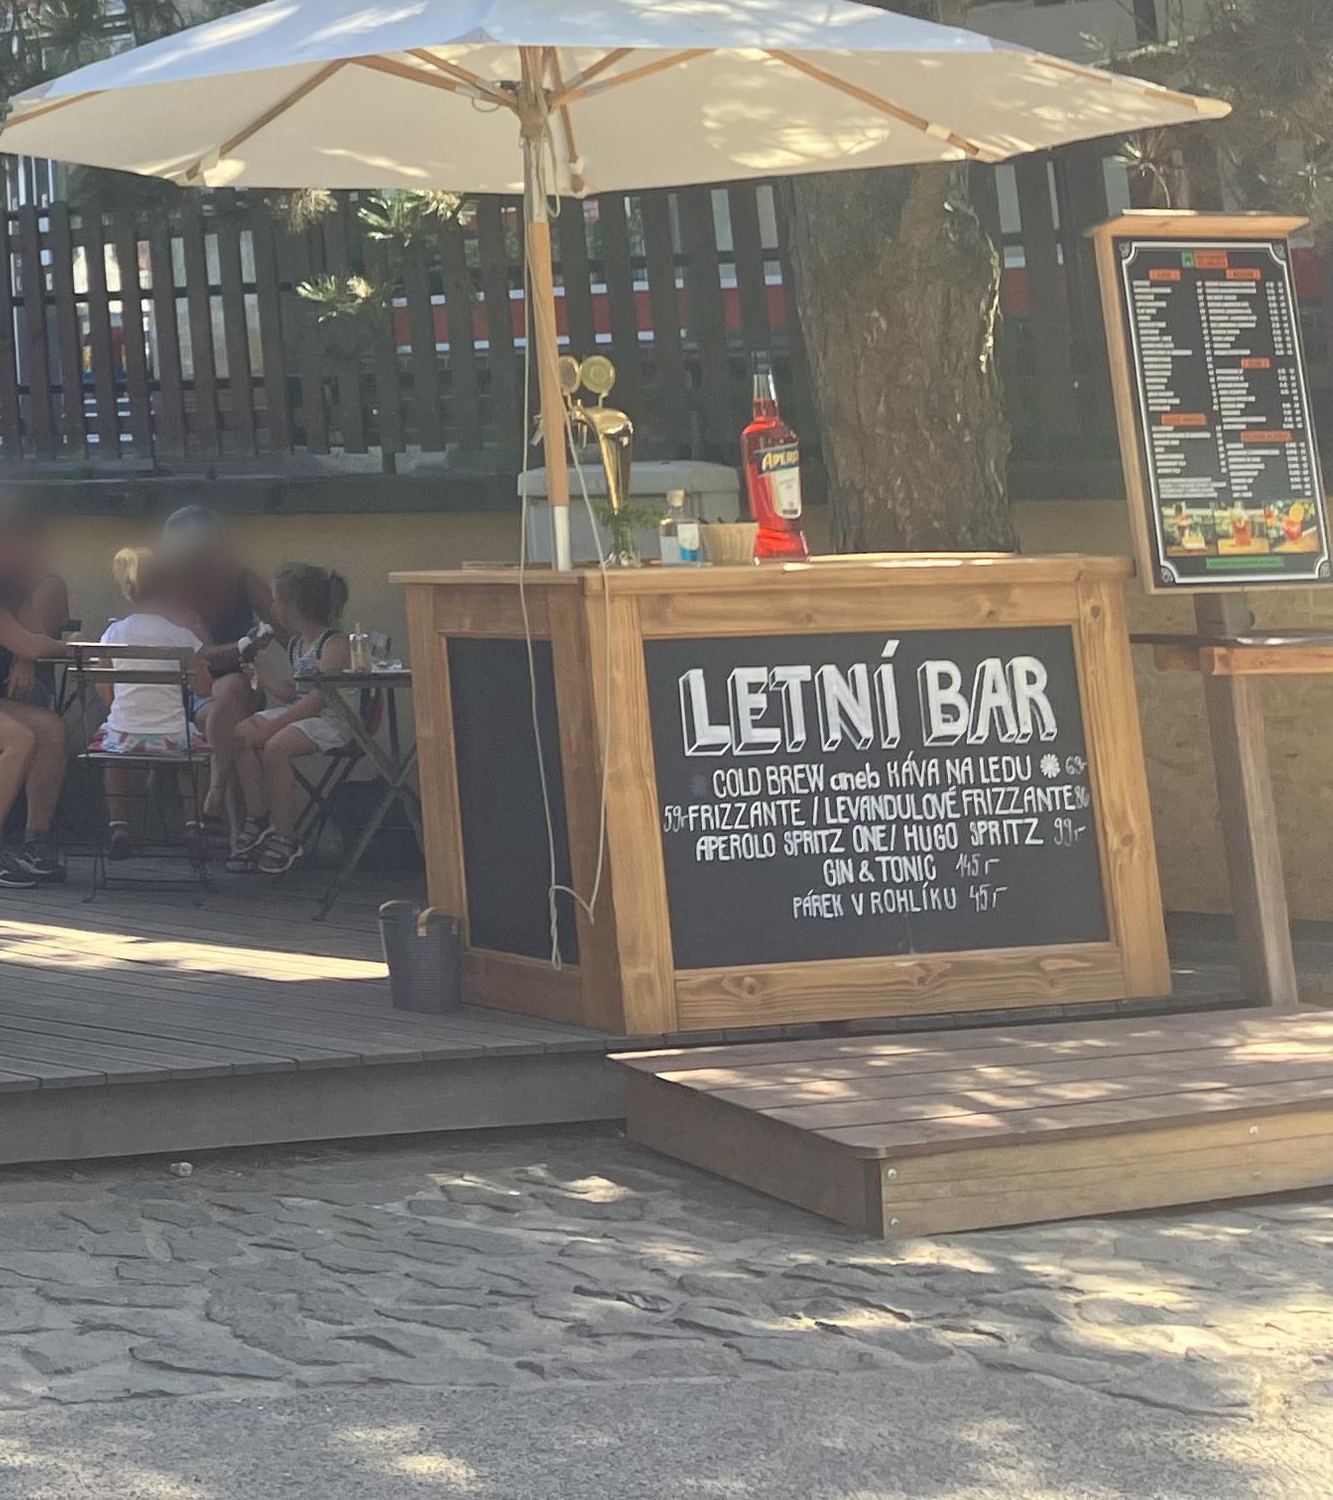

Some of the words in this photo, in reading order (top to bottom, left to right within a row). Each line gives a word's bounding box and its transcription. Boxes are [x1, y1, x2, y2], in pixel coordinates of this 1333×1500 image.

[679, 639, 900, 756] LETNÍ
[917, 655, 1057, 746] BAR
[713, 767, 761, 798] COLD
[766, 763, 825, 795] BREW
[830, 763, 880, 791] aneb
[886, 750, 941, 788] KÁVA
[946, 757, 975, 787] NA
[979, 755, 1032, 783] LEDU
[688, 799, 806, 832] FRIZZANTE
[824, 786, 960, 825] LEVANDULOVÉ
[962, 785, 1075, 816] FRIZZANTE
[696, 832, 776, 861] APEROLO
[783, 828, 845, 856] SPRITZ
[904, 822, 958, 851] HUGO
[969, 817, 1044, 846] SPRITZ
[822, 858, 854, 887] GIN
[858, 860, 875, 882] &
[875, 854, 937, 883] TONIC
[792, 889, 844, 919] PÁREK
[851, 893, 863, 916] V
[870, 881, 957, 914] ROHLÍKU
